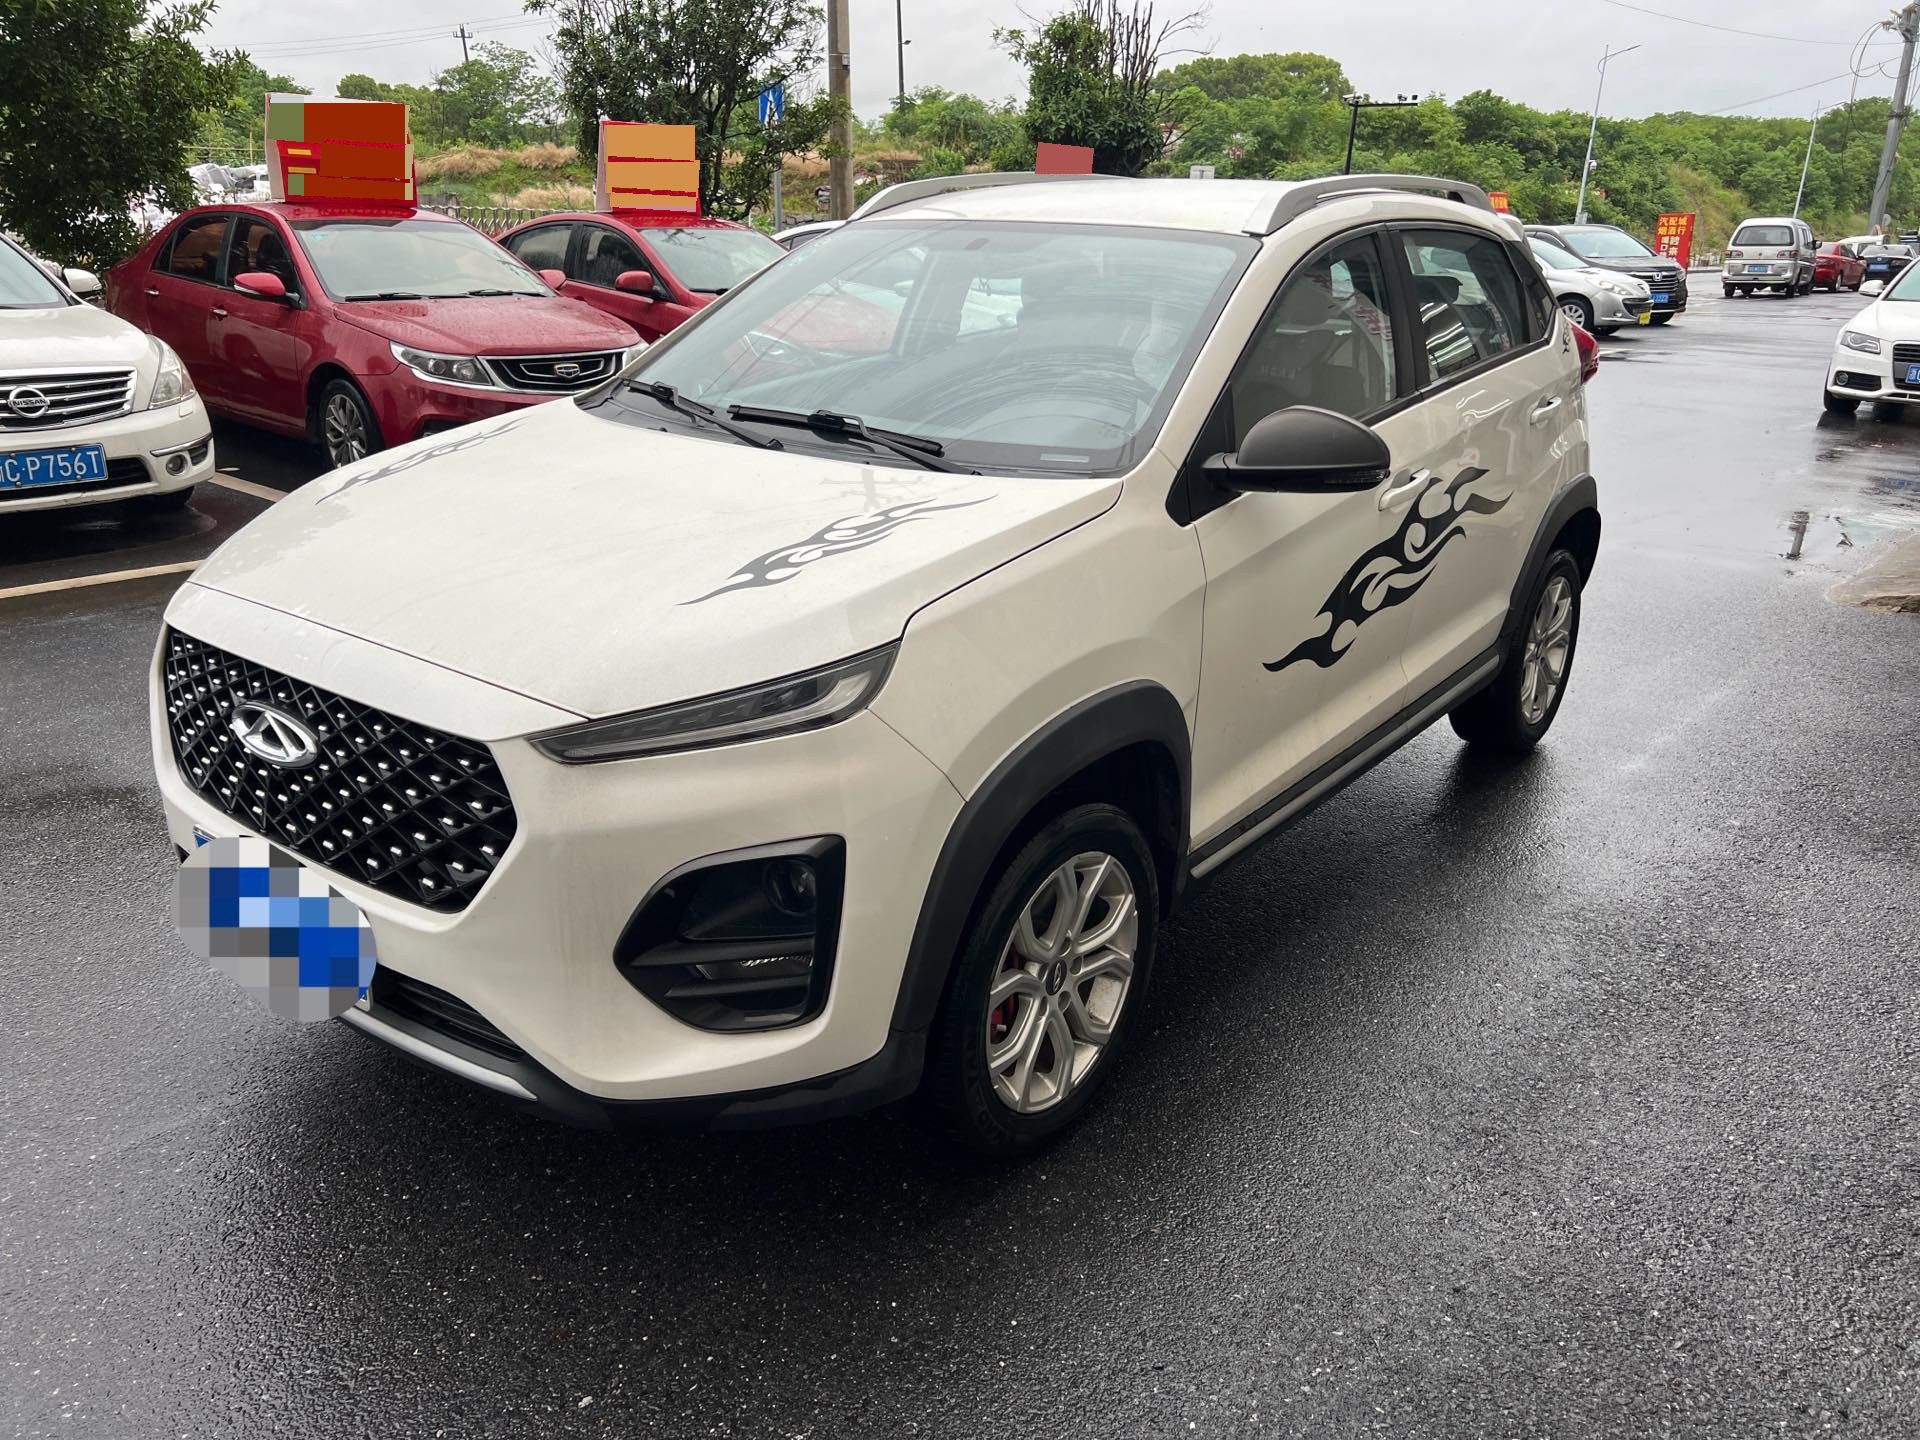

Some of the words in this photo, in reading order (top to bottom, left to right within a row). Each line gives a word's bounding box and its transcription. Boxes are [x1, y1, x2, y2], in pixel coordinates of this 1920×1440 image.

[1659, 217, 1687, 226] 汽配城
[1658, 226, 1686, 235] 烟酒行
[13, 399, 46, 407] NISSAN
[0, 451, 98, 482] C·P756T
